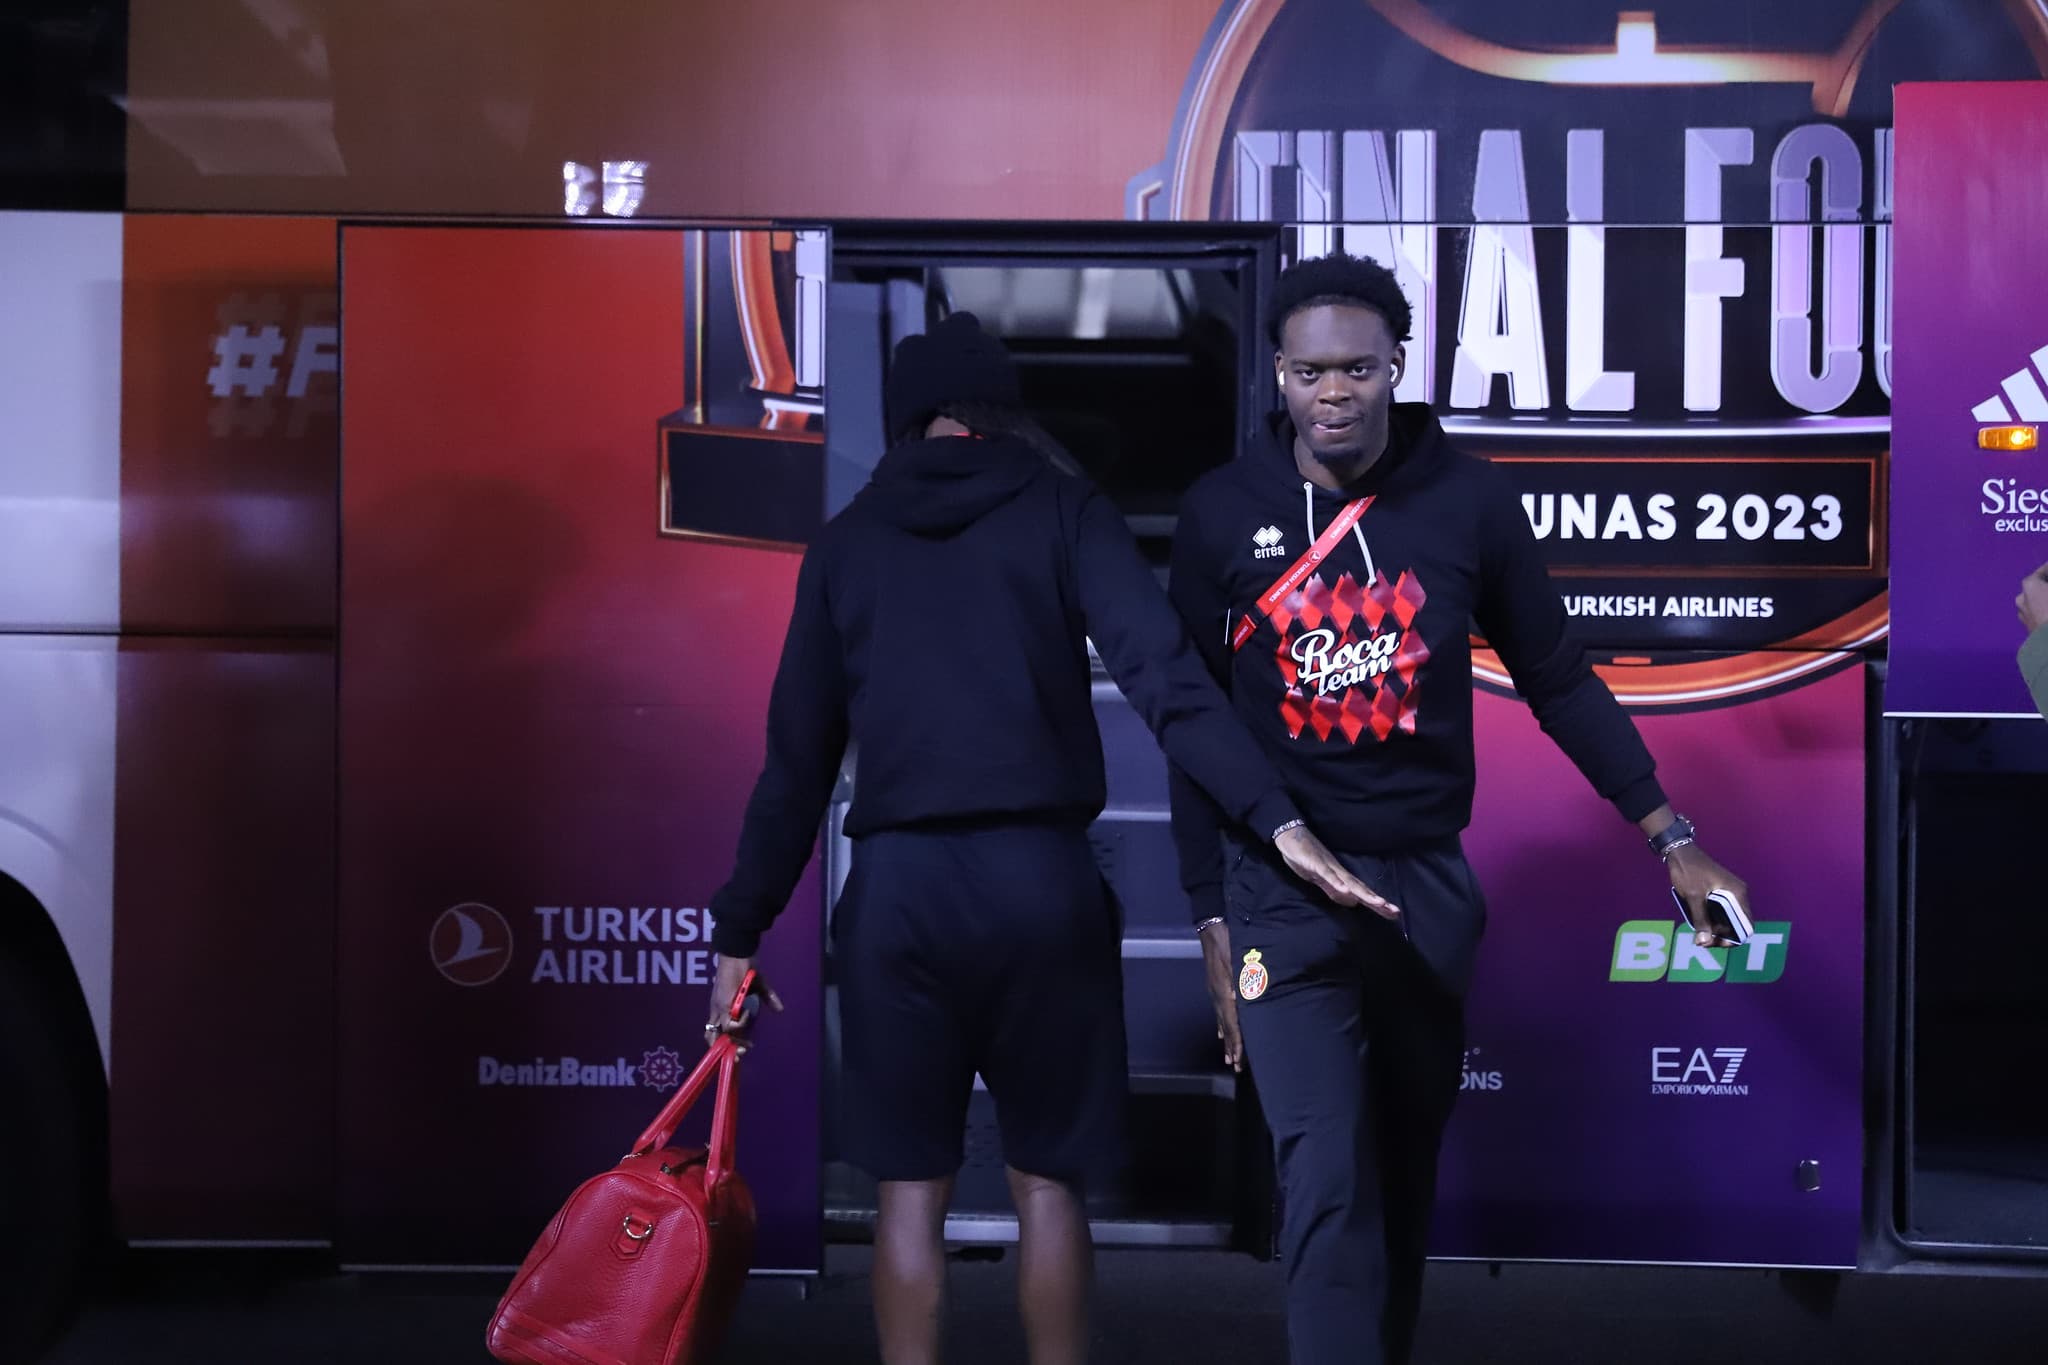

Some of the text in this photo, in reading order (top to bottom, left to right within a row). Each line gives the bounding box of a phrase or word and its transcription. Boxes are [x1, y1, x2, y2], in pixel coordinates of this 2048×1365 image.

[1683, 124, 1893, 413] FO
[1695, 493, 1843, 541] 2023
[1995, 515, 2048, 532] exclus
[1561, 596, 1774, 618] URKISH AIRLINES
[1291, 628, 1399, 679] Roca
[531, 950, 719, 985] AIRLINE
[1616, 932, 1783, 971] BKT
[479, 1055, 636, 1087] DenizBank
[1652, 1047, 1748, 1083] EA7
[1652, 1084, 1748, 1095] EMPORIO ARMANI
